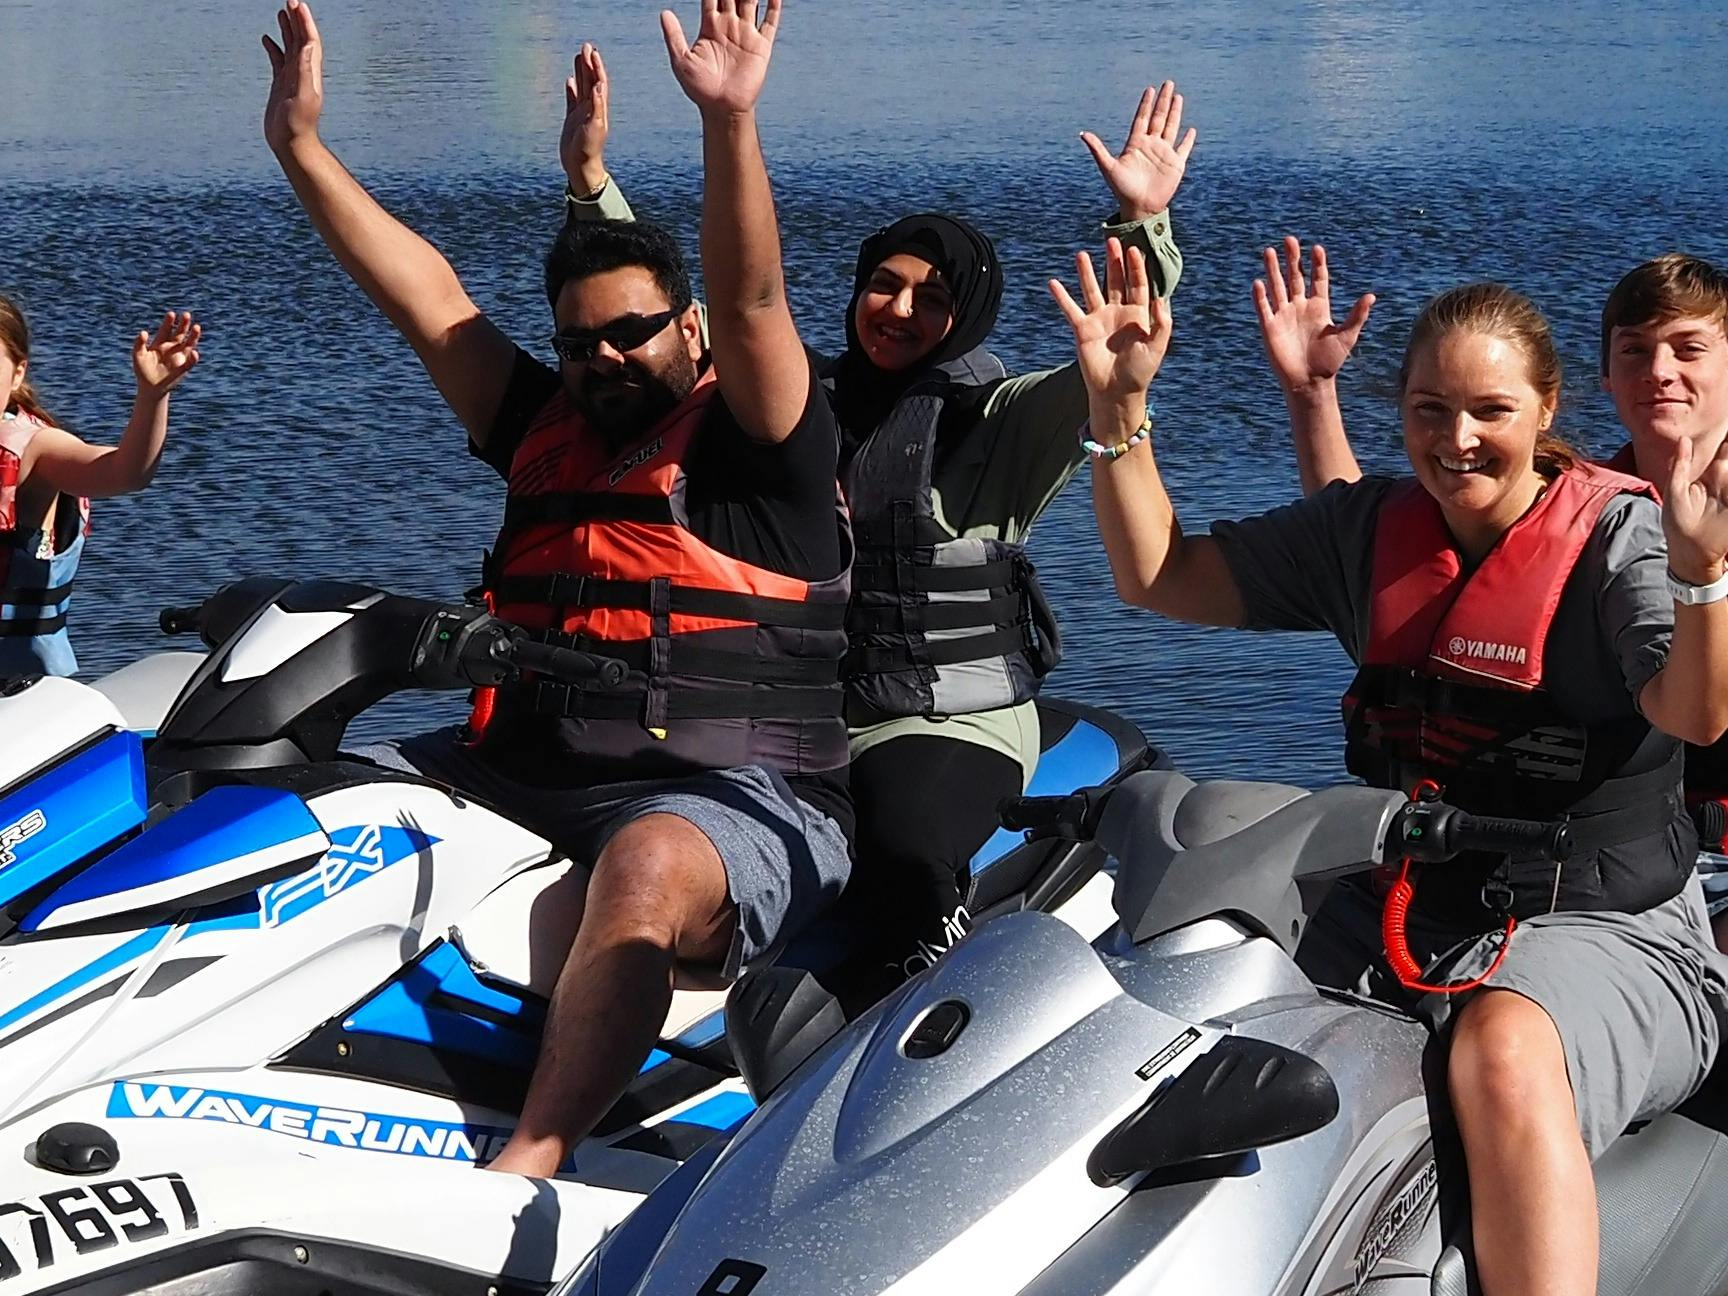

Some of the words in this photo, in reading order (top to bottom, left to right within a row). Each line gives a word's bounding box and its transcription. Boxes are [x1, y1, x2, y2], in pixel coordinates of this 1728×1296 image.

[1467, 640, 1527, 665] YAMAHA
[884, 905, 971, 979] alvin
[122, 1082, 514, 1167] WAVERUNNE
[1353, 1158, 1438, 1296] WaveRunne
